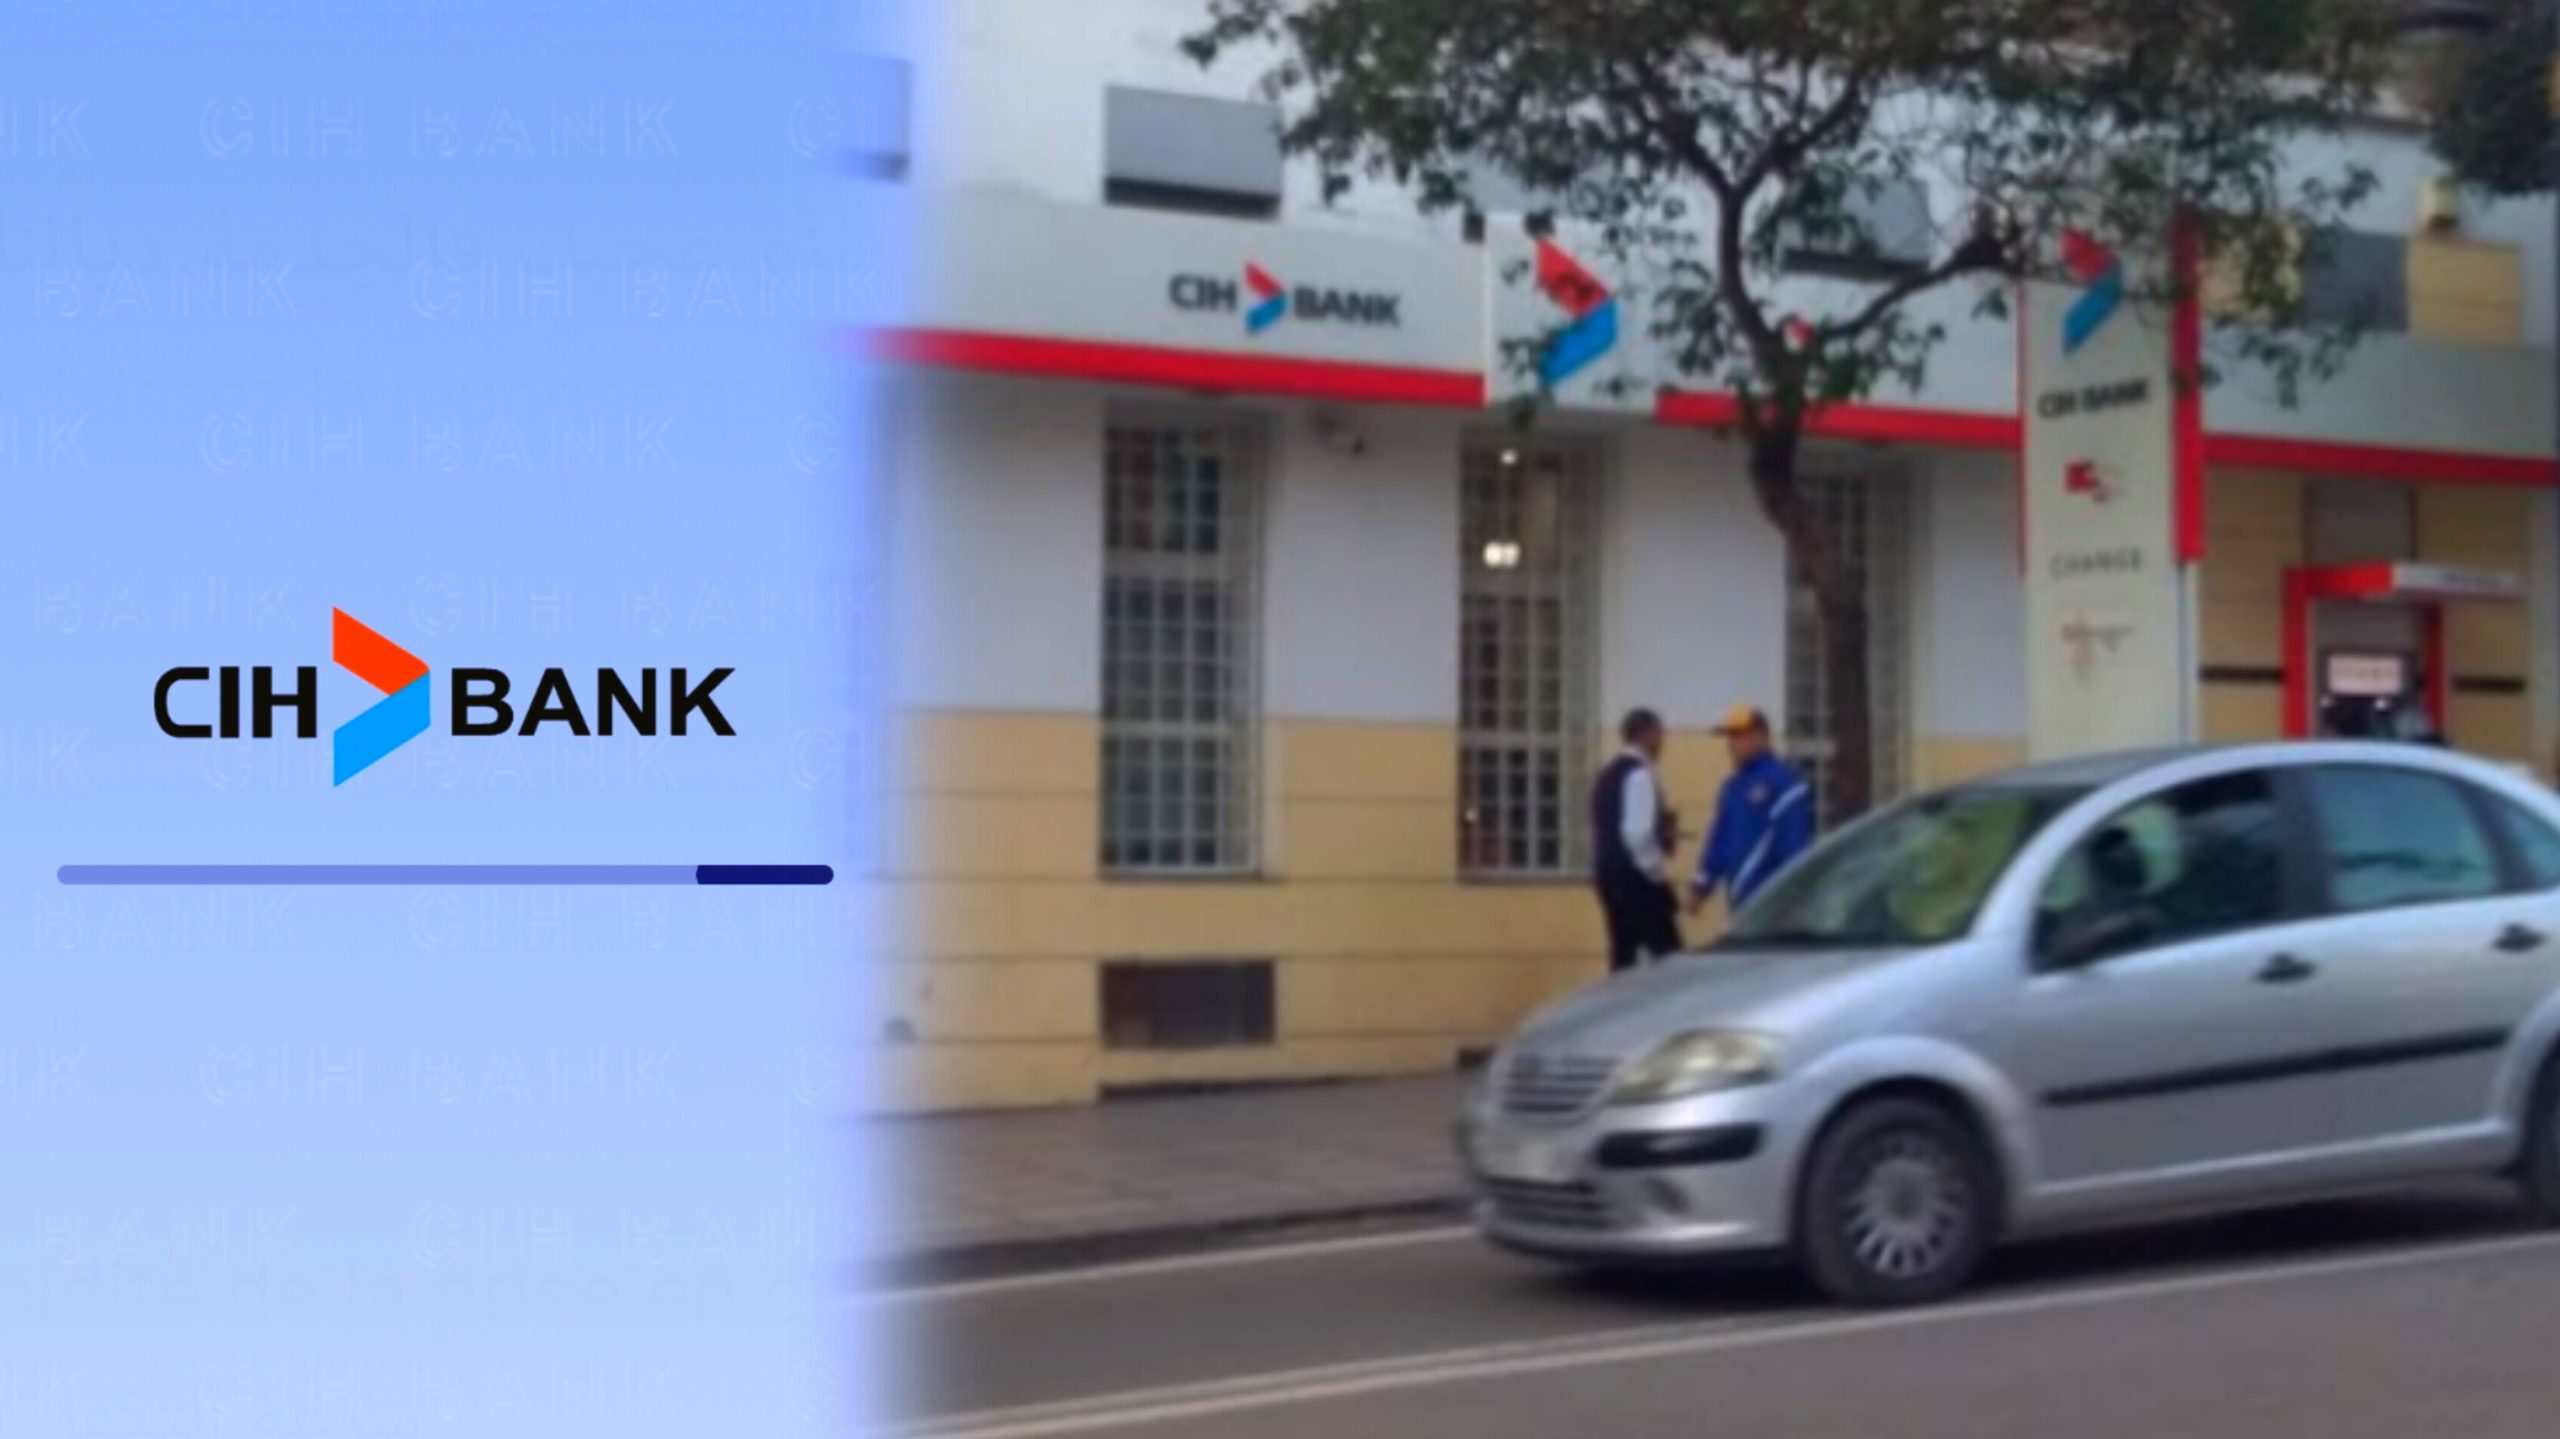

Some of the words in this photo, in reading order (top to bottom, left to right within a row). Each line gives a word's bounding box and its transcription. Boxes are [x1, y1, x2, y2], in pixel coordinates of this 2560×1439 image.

[1168, 273, 1239, 311] CIH
[1293, 286, 1402, 327] BANK
[2050, 546, 2143, 580] CHANGE
